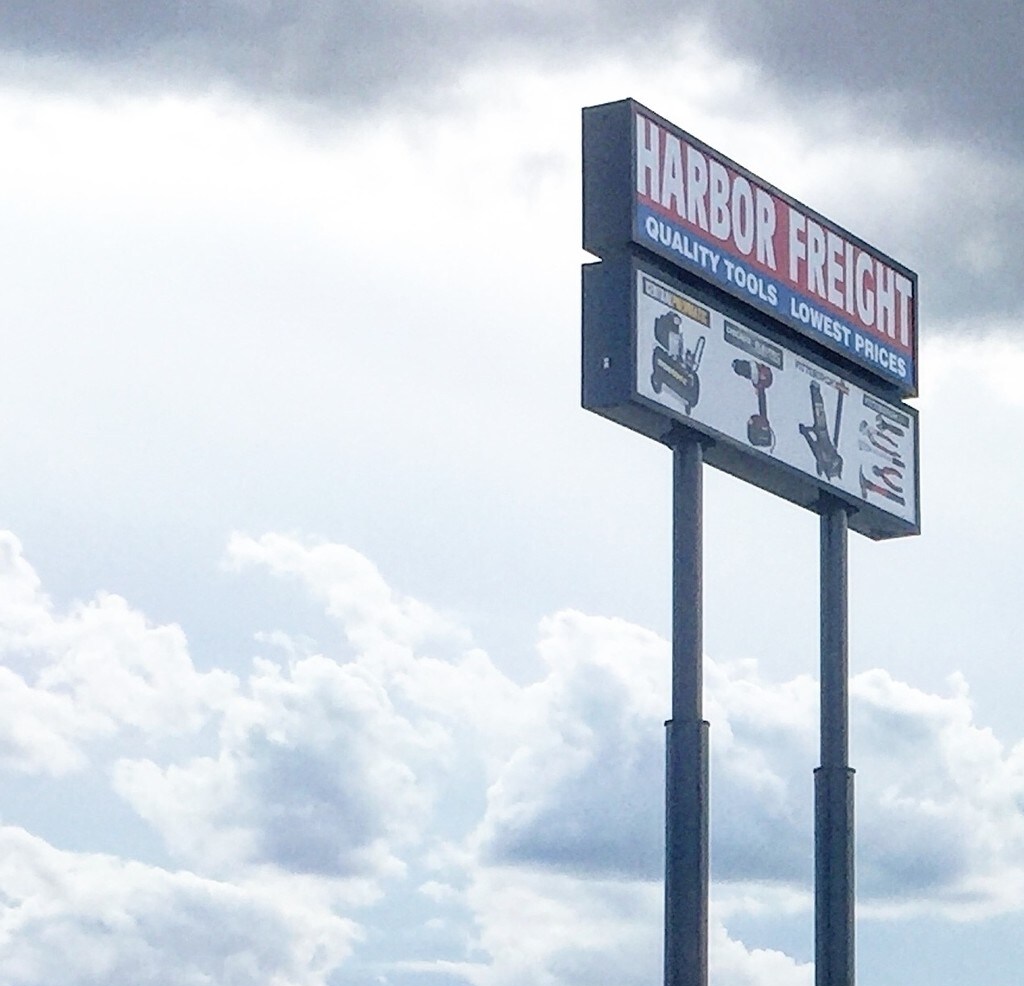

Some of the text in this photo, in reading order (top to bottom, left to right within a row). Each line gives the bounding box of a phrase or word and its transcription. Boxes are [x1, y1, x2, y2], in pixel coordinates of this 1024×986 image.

[636, 113, 913, 347] HARBOR FREIGHT
[645, 216, 720, 273] QUALITY
[723, 258, 778, 306] TOOLS
[790, 297, 851, 347] LOWEST
[855, 333, 907, 378] PRICES
